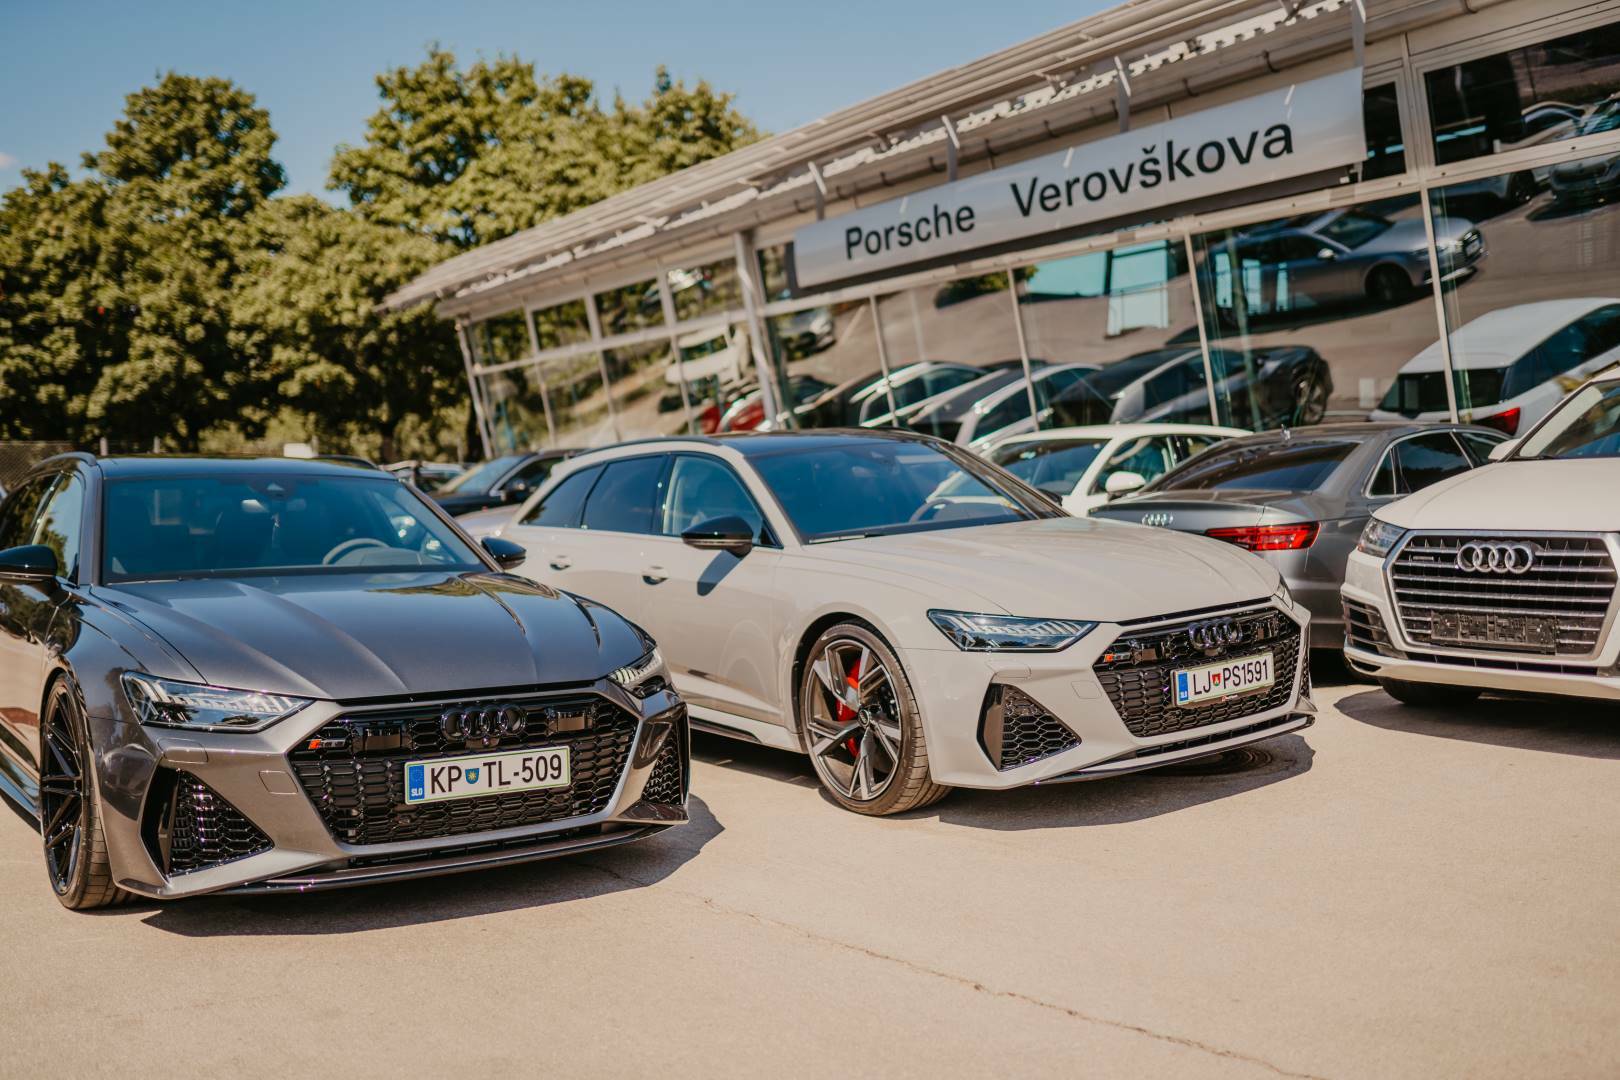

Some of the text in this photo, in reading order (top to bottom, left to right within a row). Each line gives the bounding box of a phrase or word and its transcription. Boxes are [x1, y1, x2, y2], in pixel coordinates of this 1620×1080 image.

[845, 122, 1295, 260] Porsche Verovškova
[1193, 658, 1268, 695] LJ PS1591
[430, 753, 563, 795] KP TL-509
